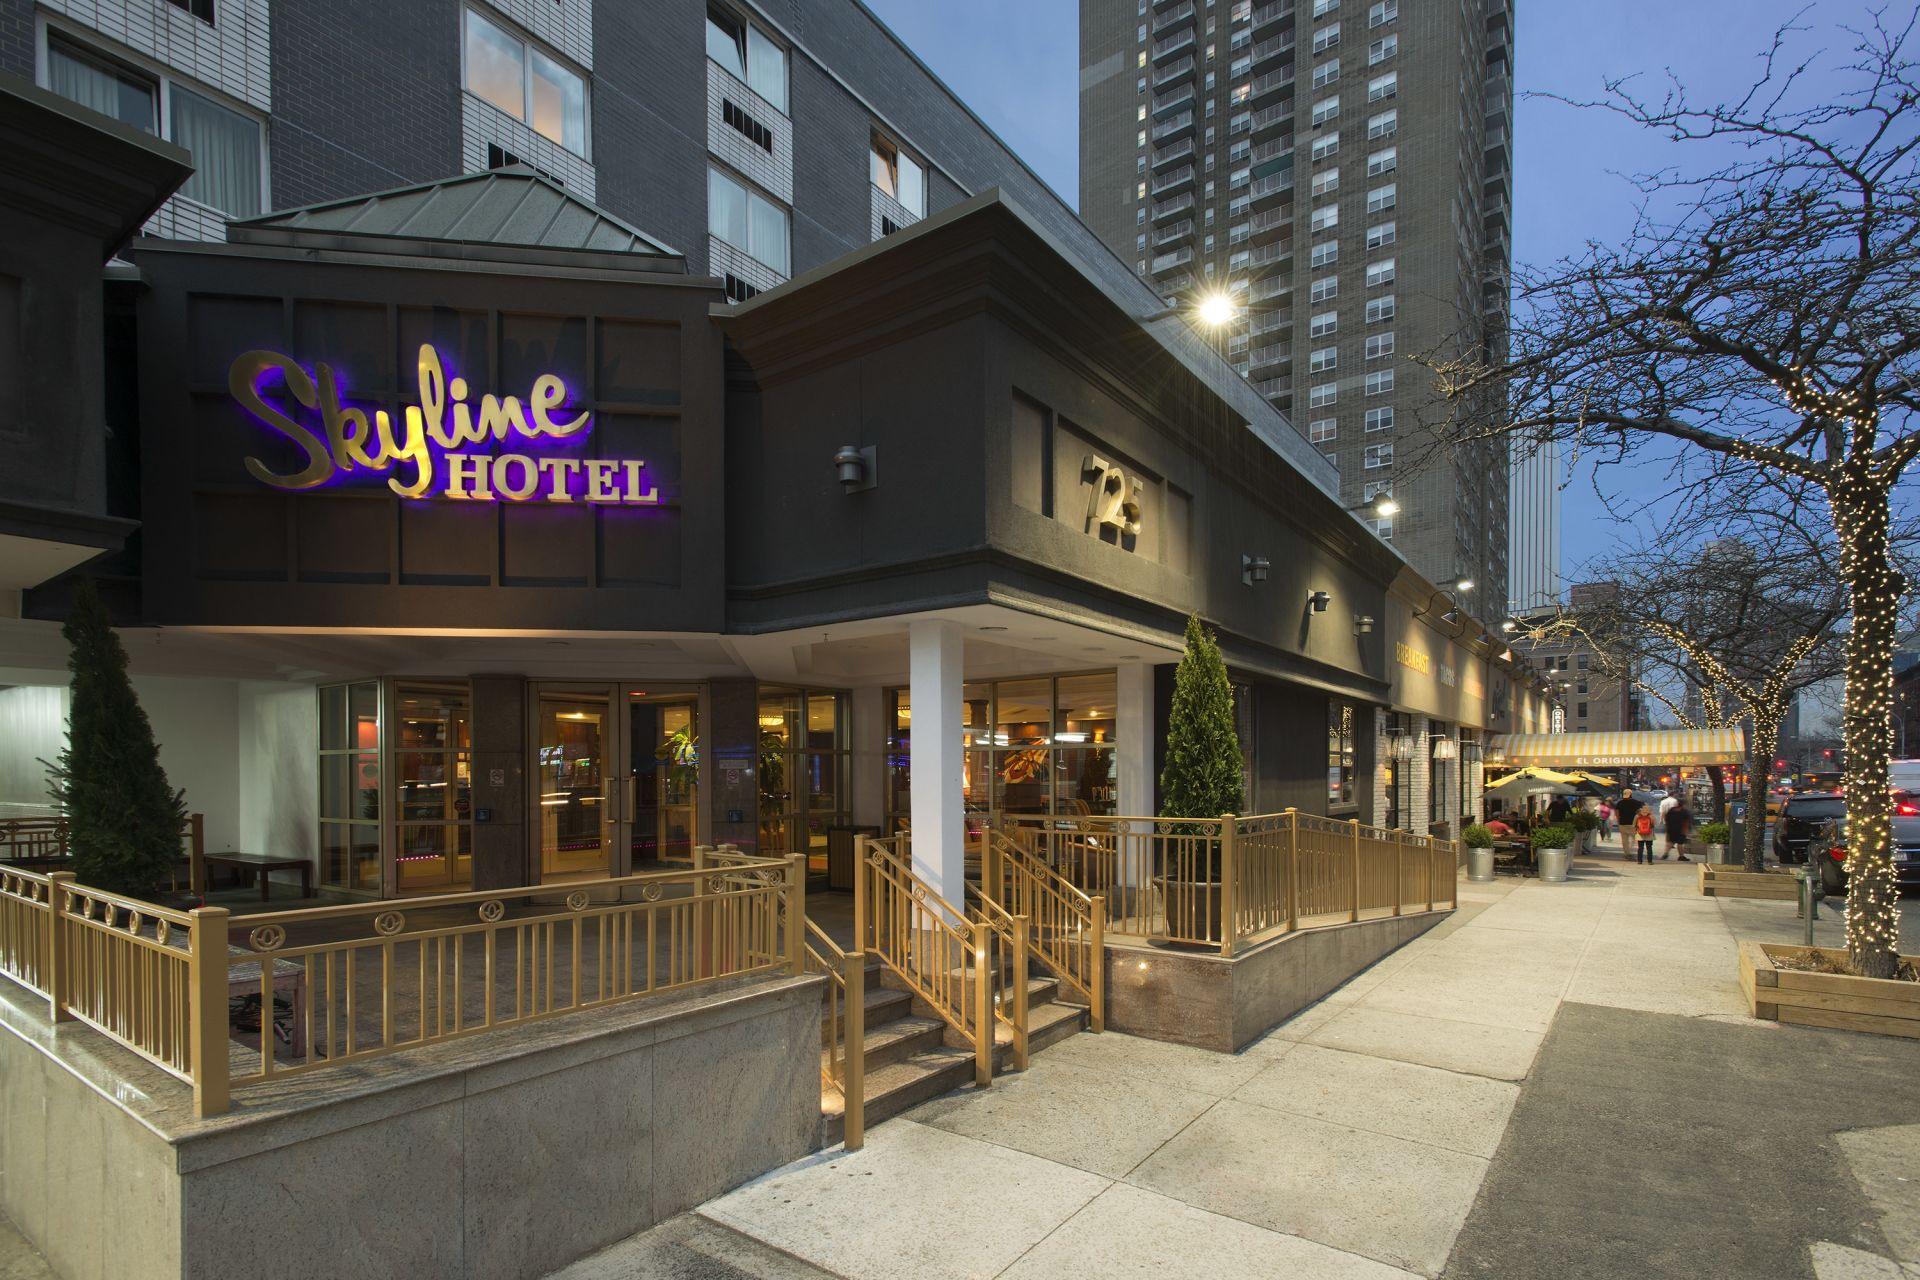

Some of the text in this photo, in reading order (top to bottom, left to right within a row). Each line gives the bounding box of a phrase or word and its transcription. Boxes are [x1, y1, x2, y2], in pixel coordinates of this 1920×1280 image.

[229, 343, 590, 499] Skyline
[444, 452, 659, 503] HOTEL
[1083, 454, 1143, 535] 725
[1396, 641, 1429, 675] BREAKFAST
[1577, 757, 1589, 765] EL
[1592, 756, 1649, 765] ORIGINAL
